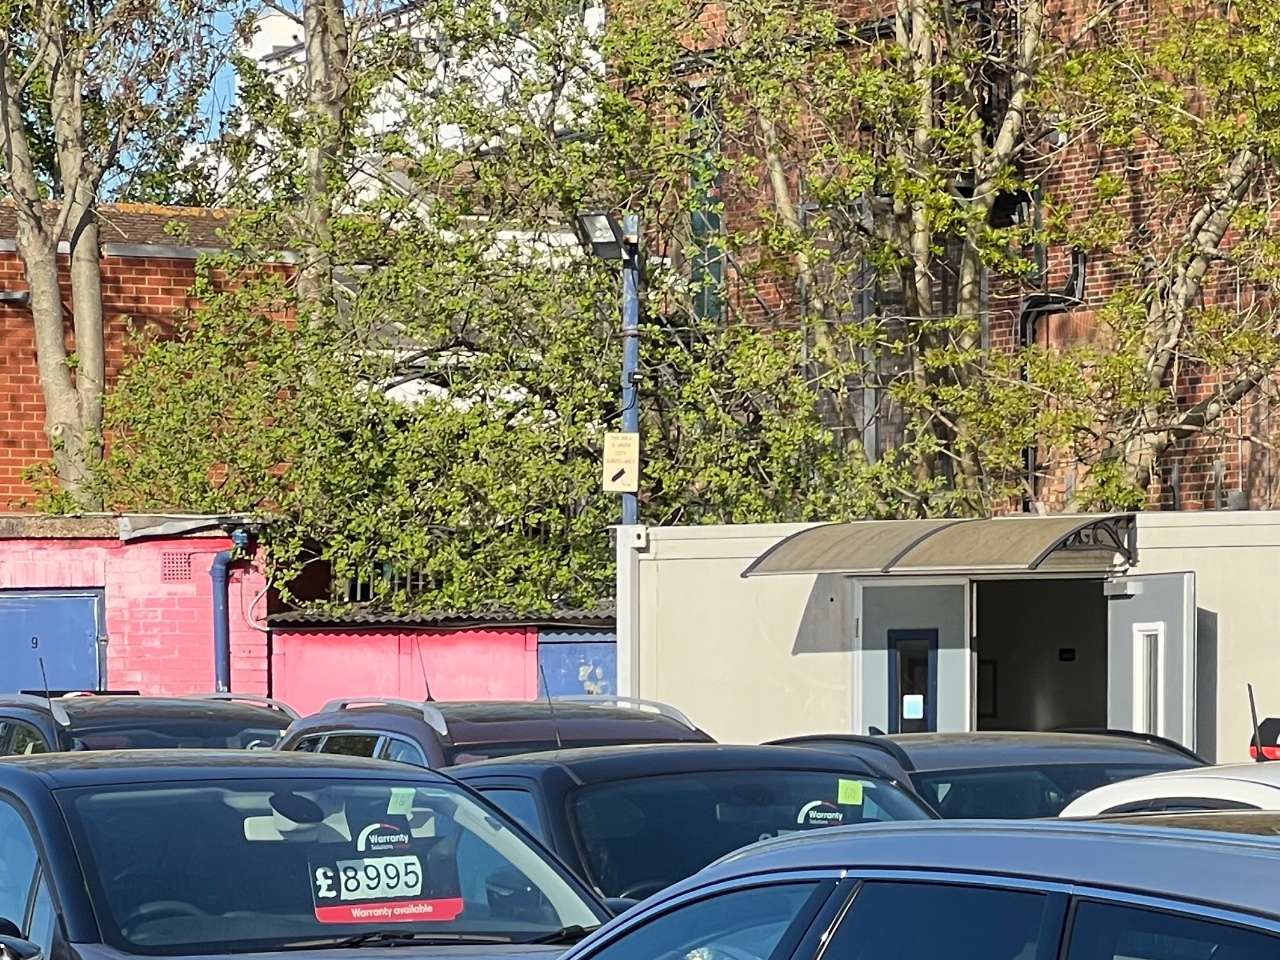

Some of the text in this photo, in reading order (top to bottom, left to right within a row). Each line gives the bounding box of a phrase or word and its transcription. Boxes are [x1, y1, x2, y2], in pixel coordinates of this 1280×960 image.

[31, 636, 38, 649] 9
[808, 810, 843, 821] Warranty
[368, 833, 409, 844] Warranty
[315, 862, 420, 898] £8995
[351, 903, 433, 918] Warranty available
